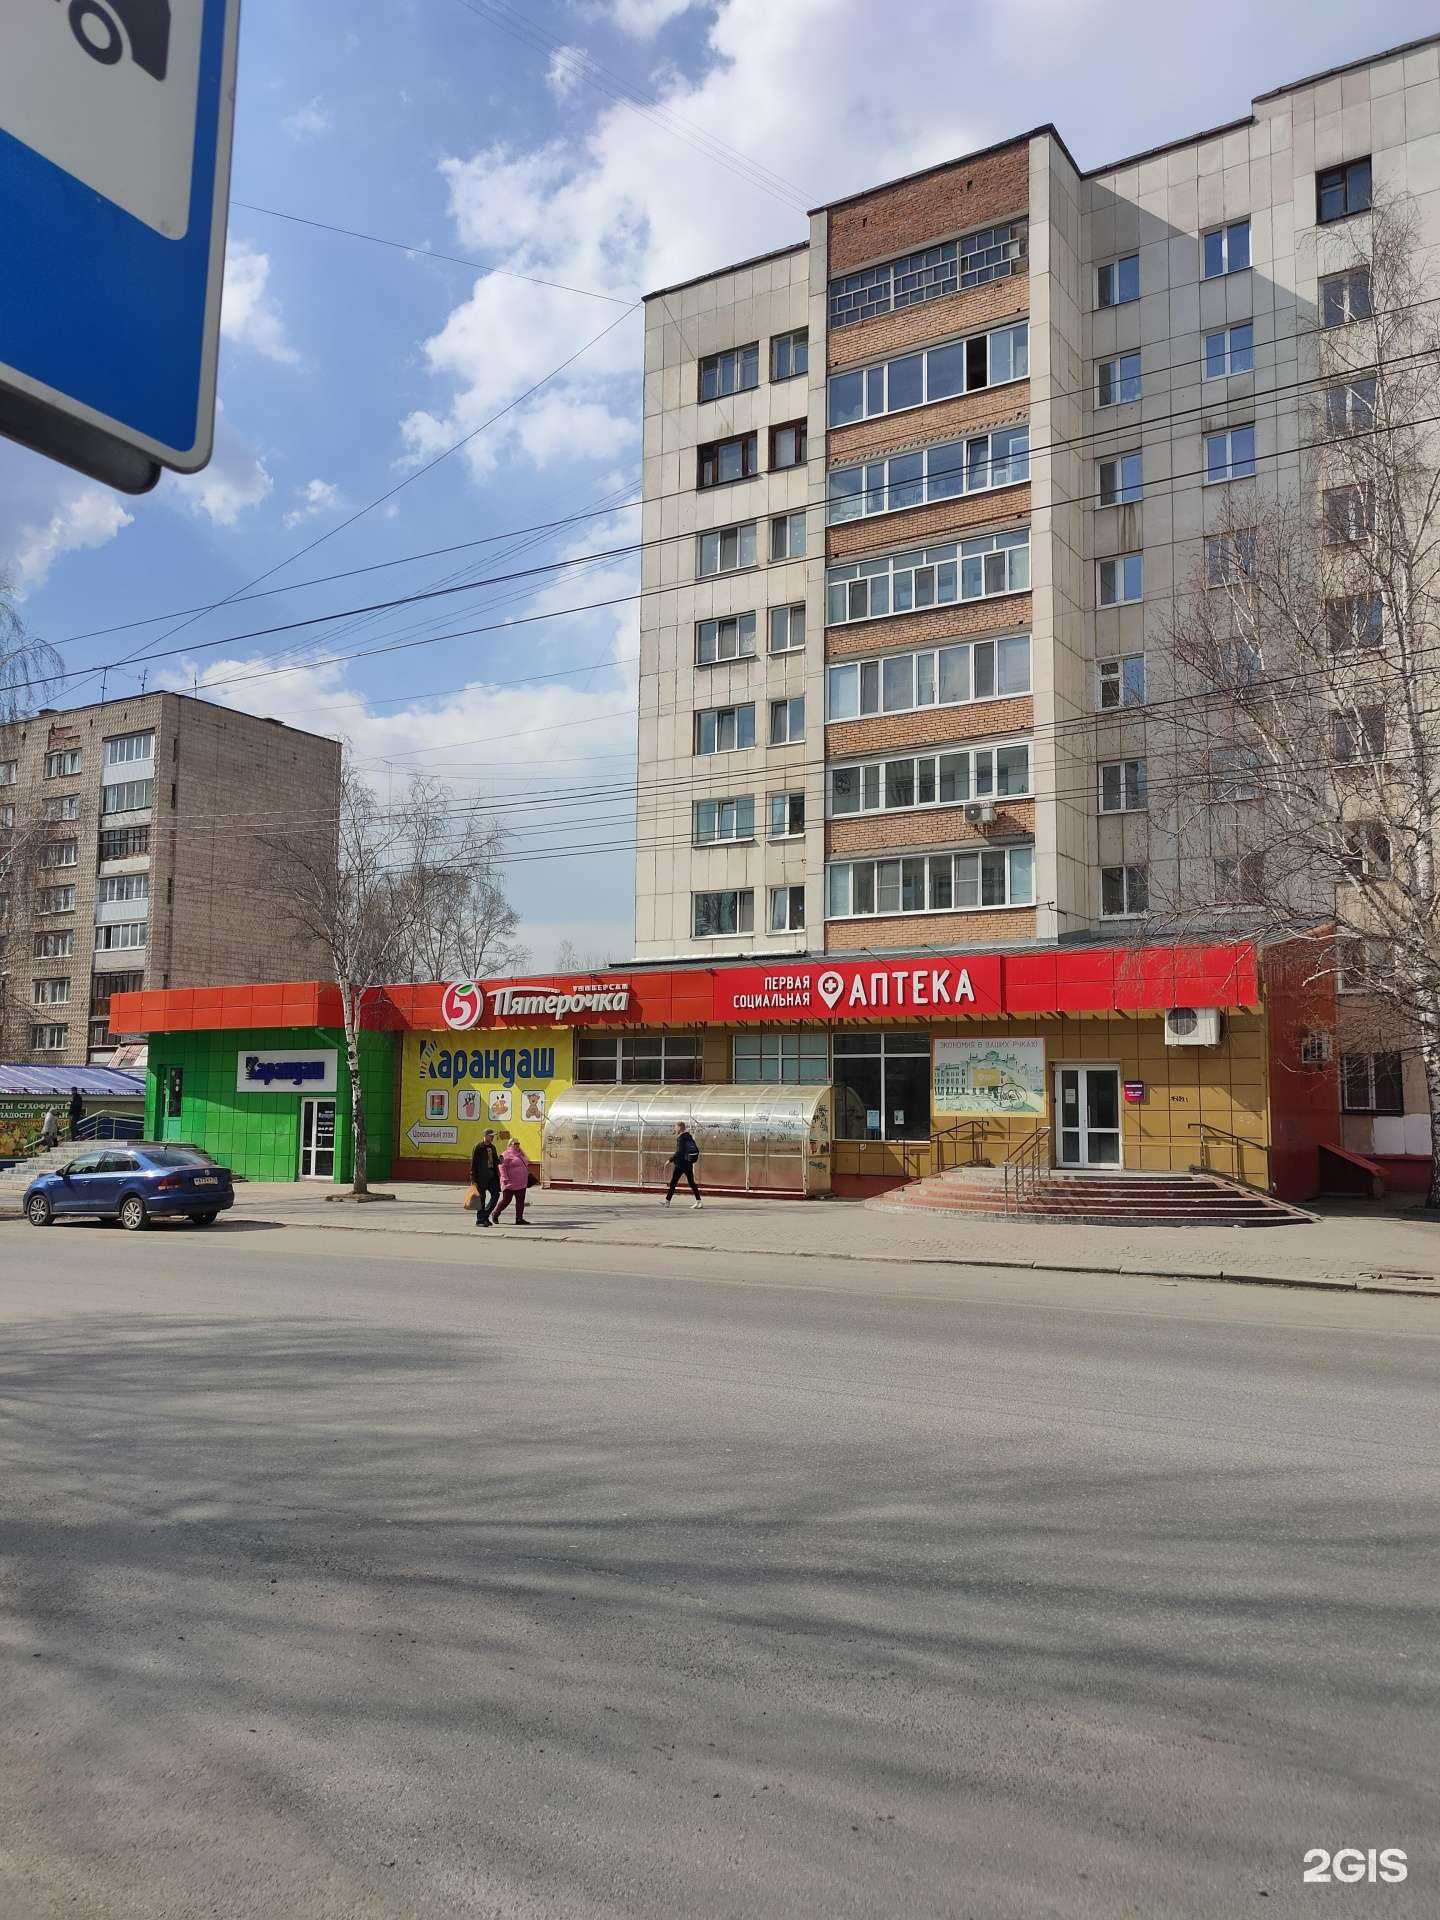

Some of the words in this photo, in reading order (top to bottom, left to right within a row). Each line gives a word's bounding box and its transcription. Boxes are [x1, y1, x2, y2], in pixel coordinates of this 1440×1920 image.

[764, 975, 810, 990] ПЕРВАЯ
[848, 968, 975, 1006] АПТЕКА
[487, 986, 628, 1020] Пятерочка
[733, 992, 810, 1009] СОЦИАЛЬНАЯ
[419, 1039, 555, 1088] Карандаш
